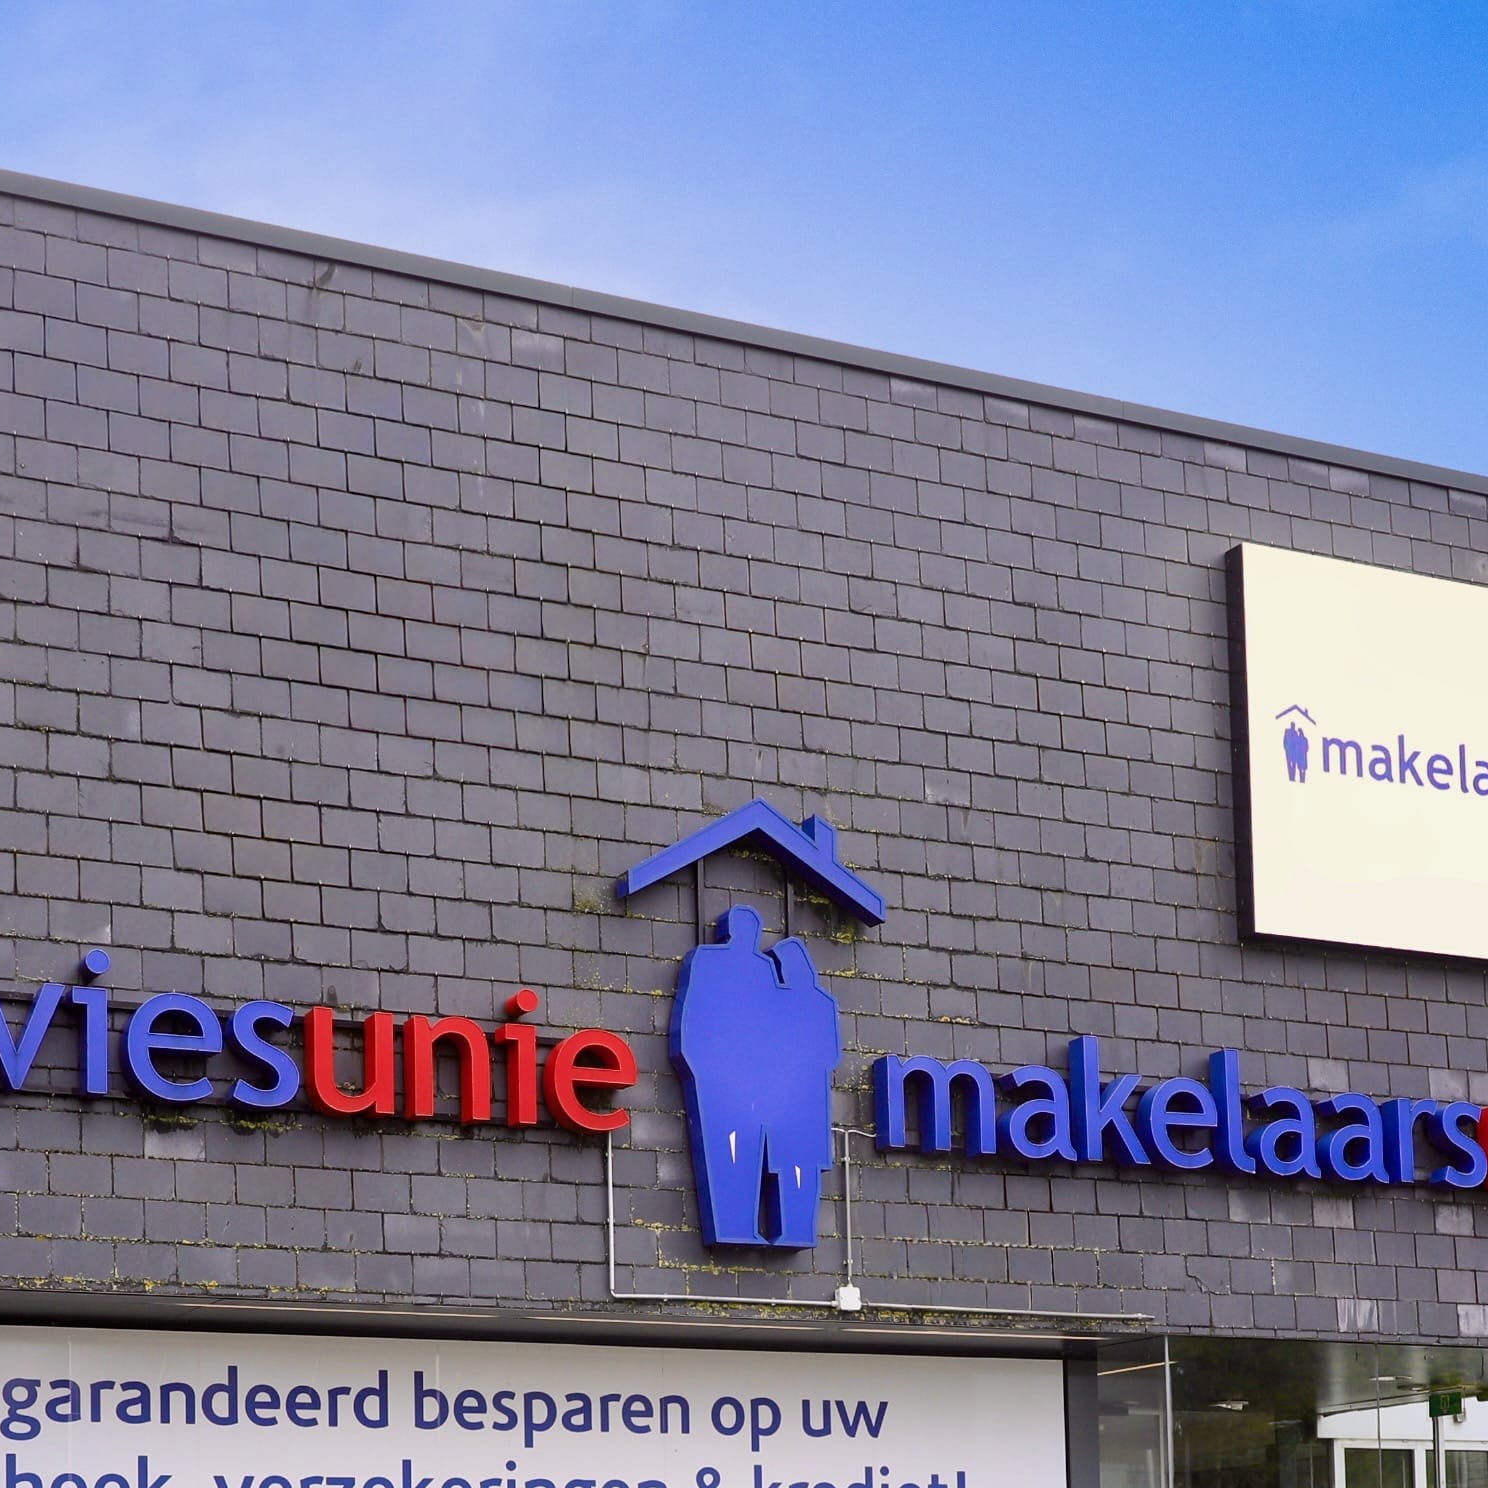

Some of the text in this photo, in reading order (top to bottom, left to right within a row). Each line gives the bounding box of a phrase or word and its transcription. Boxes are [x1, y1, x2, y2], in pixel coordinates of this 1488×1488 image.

[414, 1371, 690, 1448] besparen
[711, 1396, 782, 1452] op
[802, 1399, 889, 1438] uw
